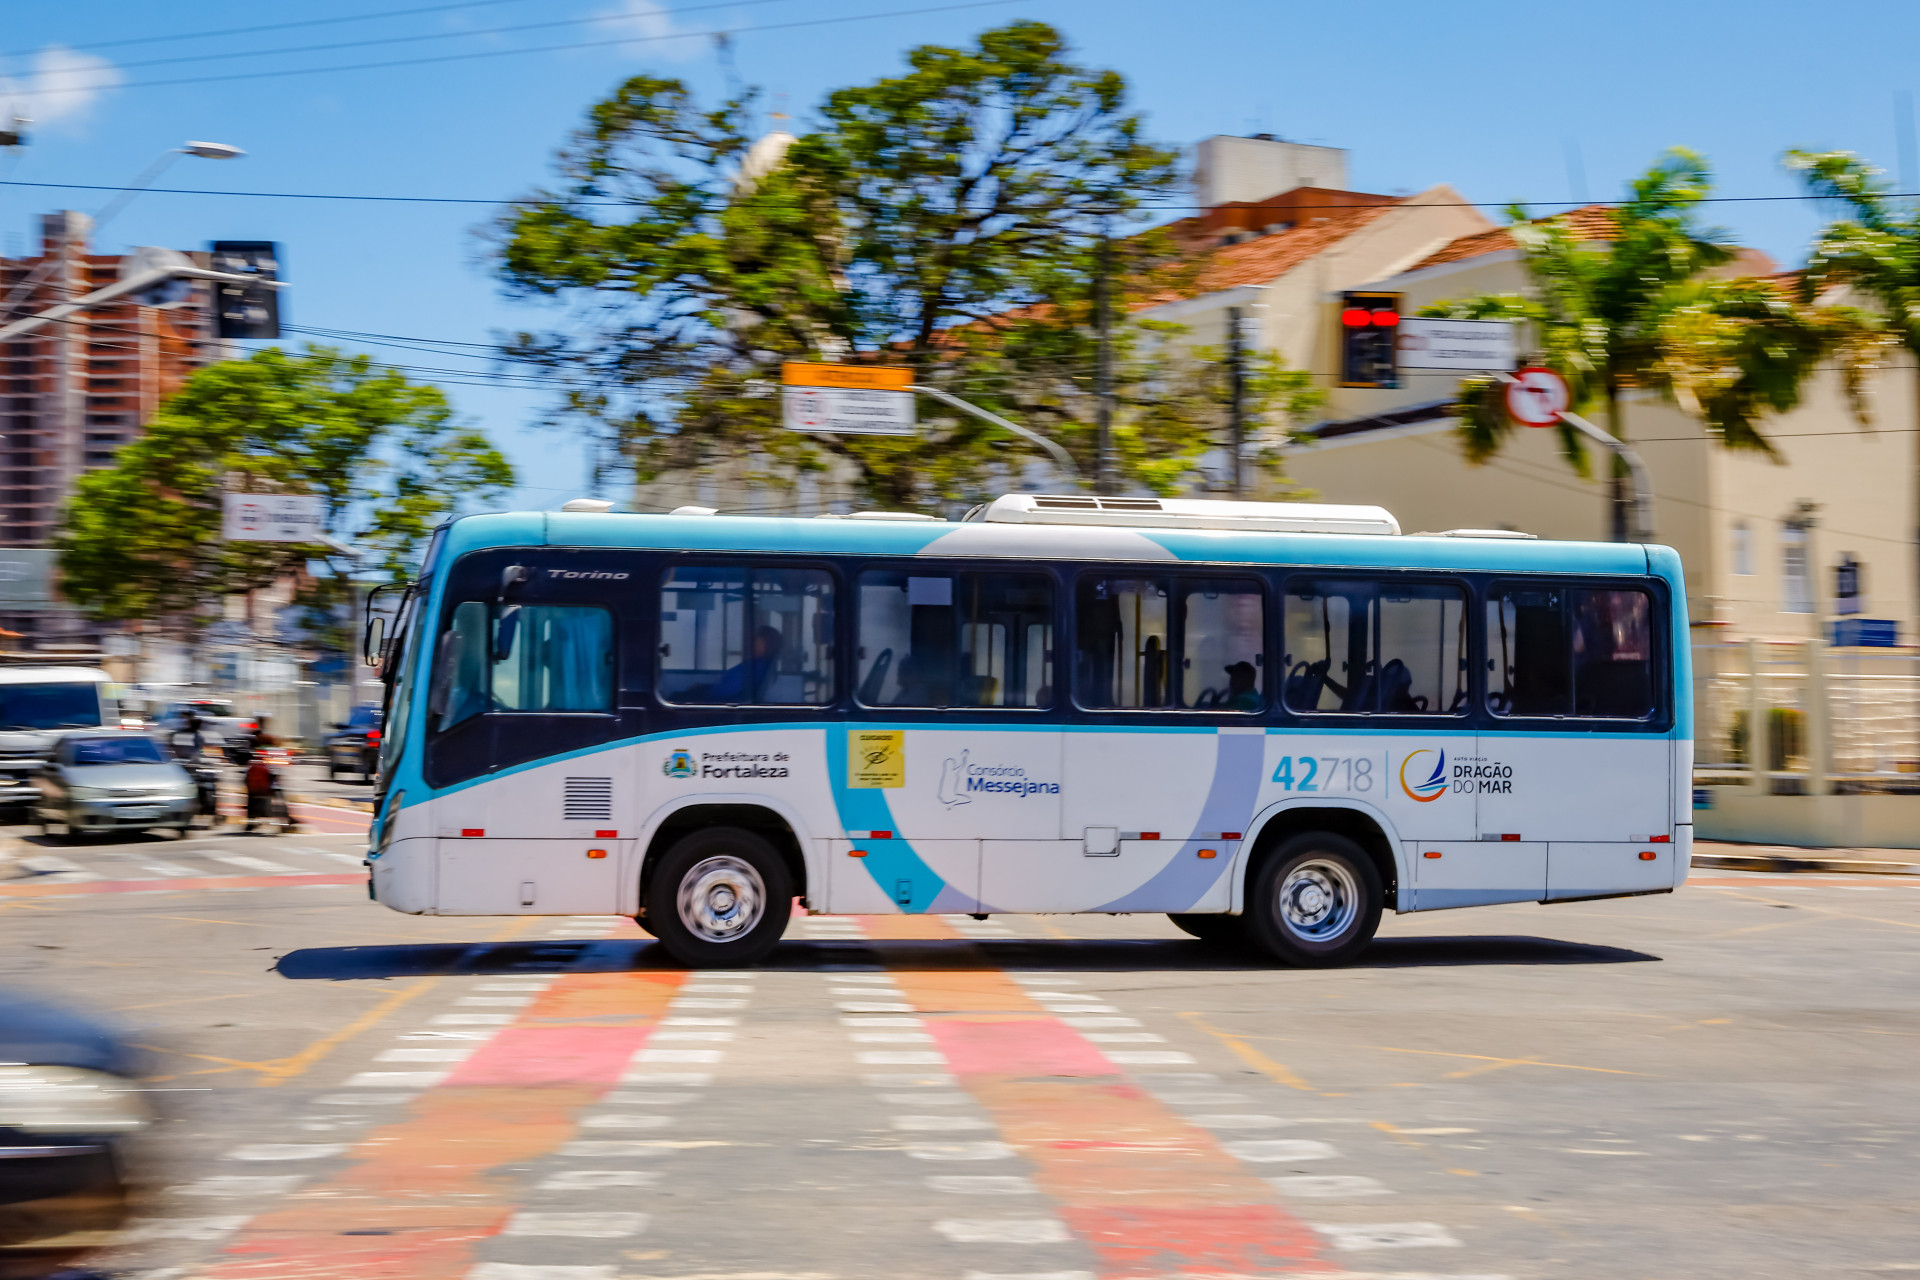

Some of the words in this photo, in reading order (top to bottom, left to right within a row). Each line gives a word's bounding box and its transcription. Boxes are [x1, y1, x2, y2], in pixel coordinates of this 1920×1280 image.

[547, 569, 630, 580] Torino
[702, 752, 769, 762] Prefeitura
[773, 752, 790, 762] de
[702, 764, 789, 778] Fortaleza
[966, 763, 1025, 777] Consórcio
[1272, 756, 1373, 792] 42718
[1453, 762, 1513, 778] DRAGÃO
[966, 777, 1060, 798] Messejana
[1453, 780, 1475, 794] DO
[1478, 780, 1513, 794] MAR
